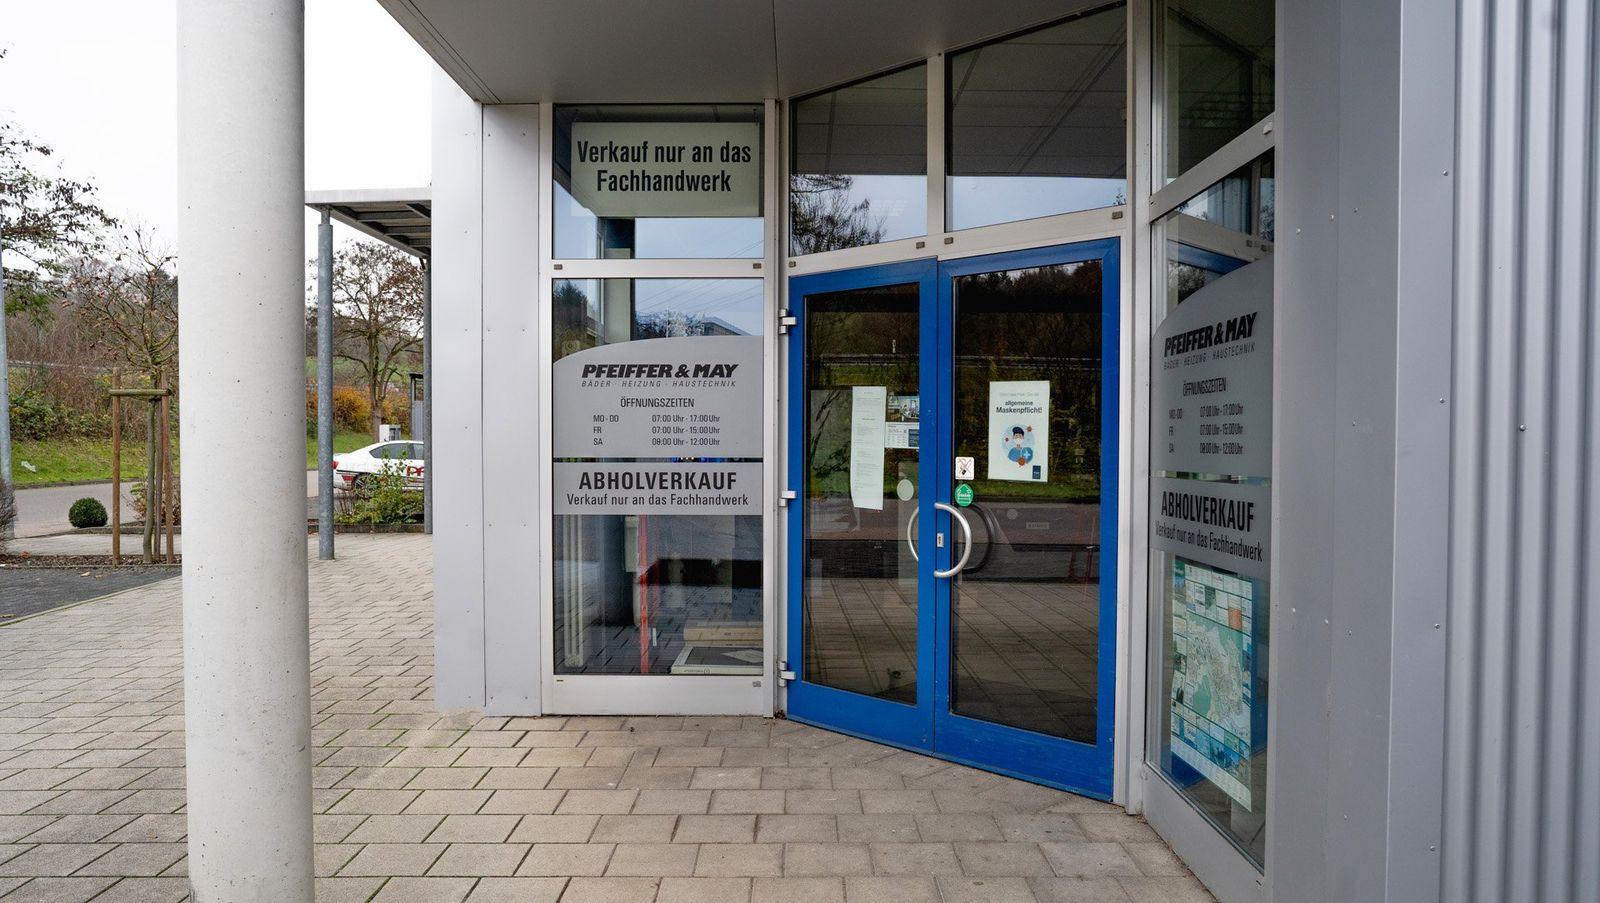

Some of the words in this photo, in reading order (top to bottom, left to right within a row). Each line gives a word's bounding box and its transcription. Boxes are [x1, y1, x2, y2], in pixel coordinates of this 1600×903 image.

[577, 140, 649, 163] Verkauf
[655, 145, 685, 163] nur
[692, 145, 713, 163] an
[720, 140, 751, 163] das
[597, 170, 732, 192] Fachhandwerk
[1164, 325, 1213, 357] PFEIFFER
[1213, 322, 1225, 346] &
[1225, 312, 1258, 342] MAY
[1212, 341, 1256, 360] HAUSTECHNIK
[581, 363, 673, 379] PFEIFFER
[675, 363, 691, 379] &
[692, 363, 739, 379] MAY
[581, 380, 612, 388] BÄDER
[622, 380, 662, 388] HEIZUNG
[672, 380, 737, 388] HAUSTECHNIK
[1183, 377, 1227, 397] ÖFFNUNGSZEITEN
[620, 396, 695, 408] ÖFFNUNGSZEITEN
[996, 406, 1042, 415] Maskenpflicht!
[593, 414, 605, 423] MO
[609, 414, 619, 423] DO
[651, 414, 672, 423] 07:00
[673, 414, 685, 423] Uhr
[690, 414, 708, 423] 17:00
[708, 414, 720, 423] Uhr
[593, 425, 602, 434] FR
[651, 425, 672, 434] 07:00
[673, 425, 685, 434] Uhr
[690, 425, 708, 434] 15:00
[708, 425, 720, 434] Uhr
[593, 437, 604, 446] SA
[673, 437, 685, 446] Uhr
[690, 437, 708, 446] 12:00
[708, 437, 720, 446] Uhr
[579, 471, 737, 491] ABHOLVERKAUF
[567, 493, 608, 506] Verkauf
[611, 496, 629, 506] nur
[633, 496, 645, 506] an
[648, 493, 667, 506] das
[670, 493, 749, 506] Fachhandwerk
[1161, 491, 1254, 532] ABHOLVERKAUF
[1155, 521, 1176, 540] Verkauf
[1177, 529, 1187, 543] nur
[1188, 531, 1196, 544] an
[1197, 530, 1208, 548] das
[1210, 532, 1262, 562] Fachhandwerk
